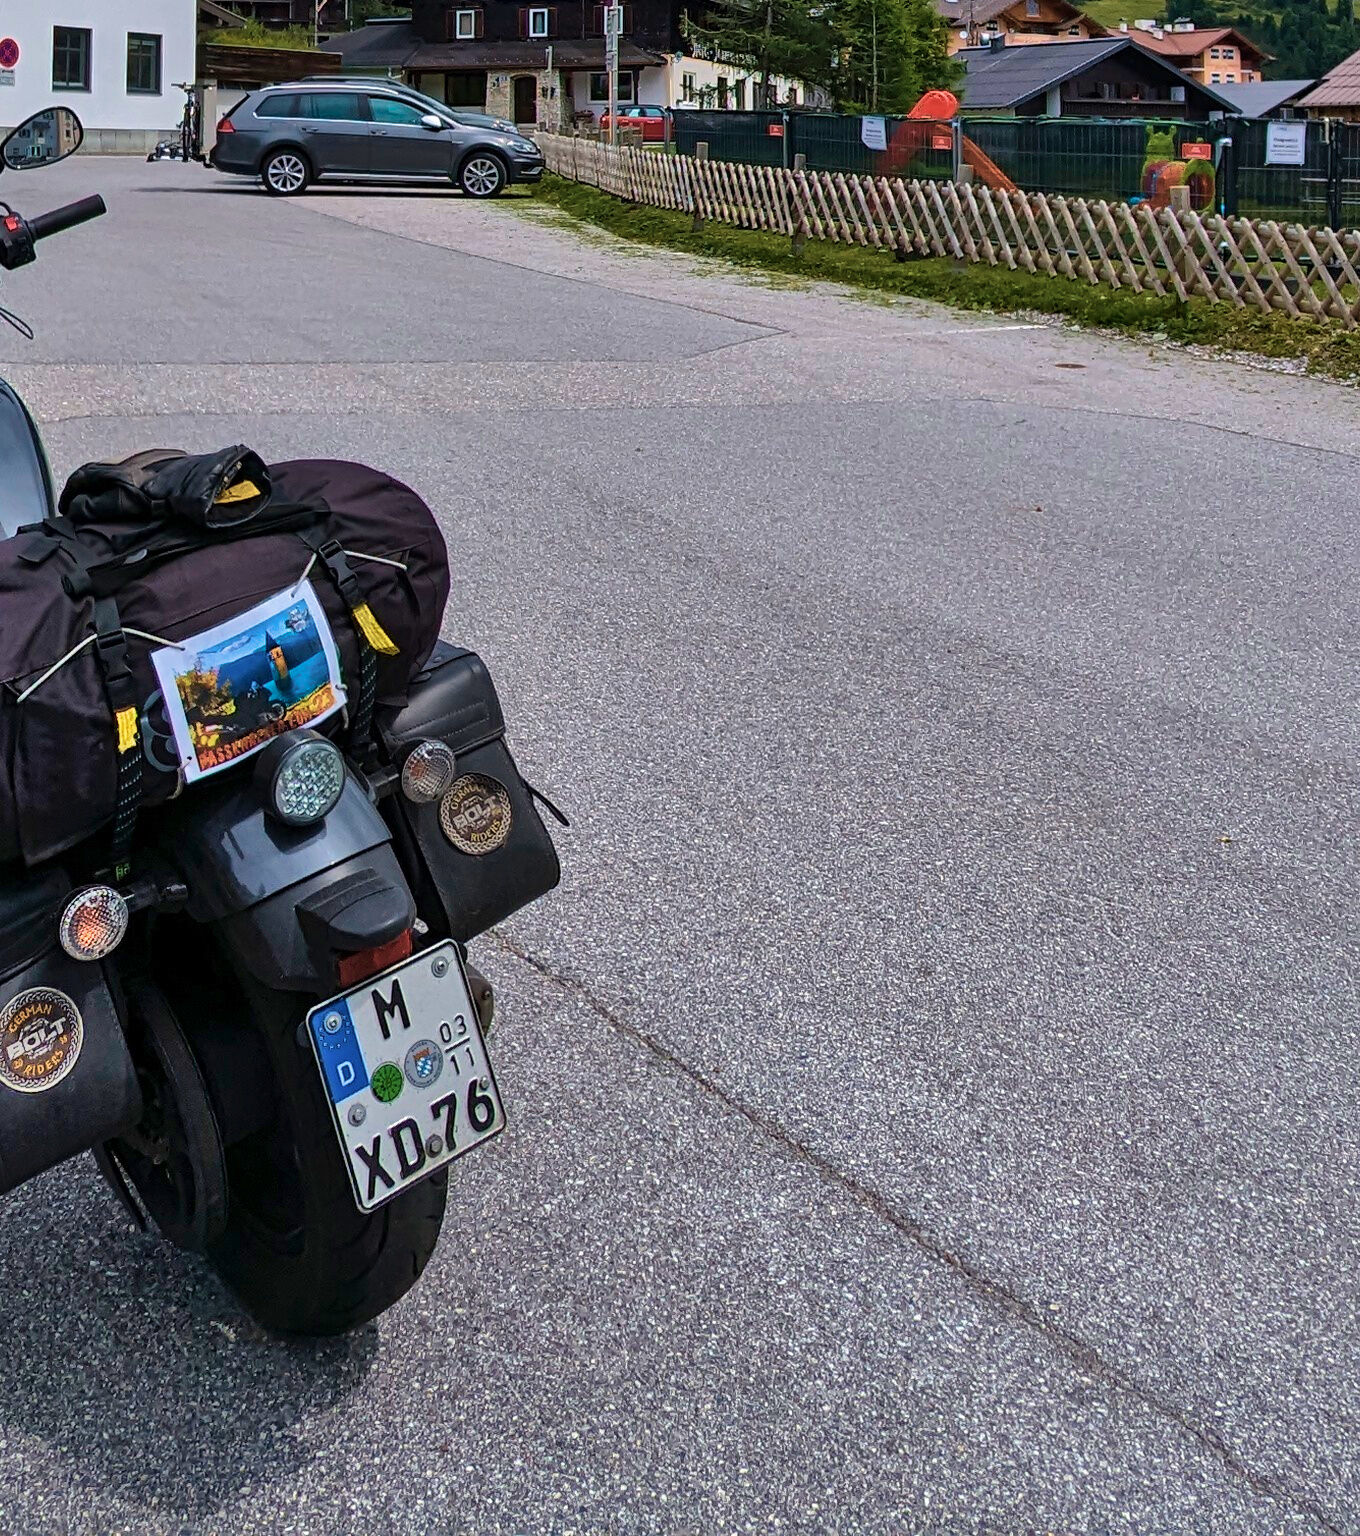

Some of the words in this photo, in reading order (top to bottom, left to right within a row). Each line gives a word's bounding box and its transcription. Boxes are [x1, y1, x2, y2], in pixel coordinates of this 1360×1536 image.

[7, 1004, 53, 1034] GERMAN
[371, 977, 412, 1040] M
[6, 1016, 67, 1061] BOLT
[439, 1014, 467, 1044] 03
[23, 1049, 64, 1077] RIDERS
[337, 1061, 356, 1087] D
[449, 1047, 476, 1076] 11
[354, 1117, 427, 1201] XD
[429, 1077, 496, 1153] 76
